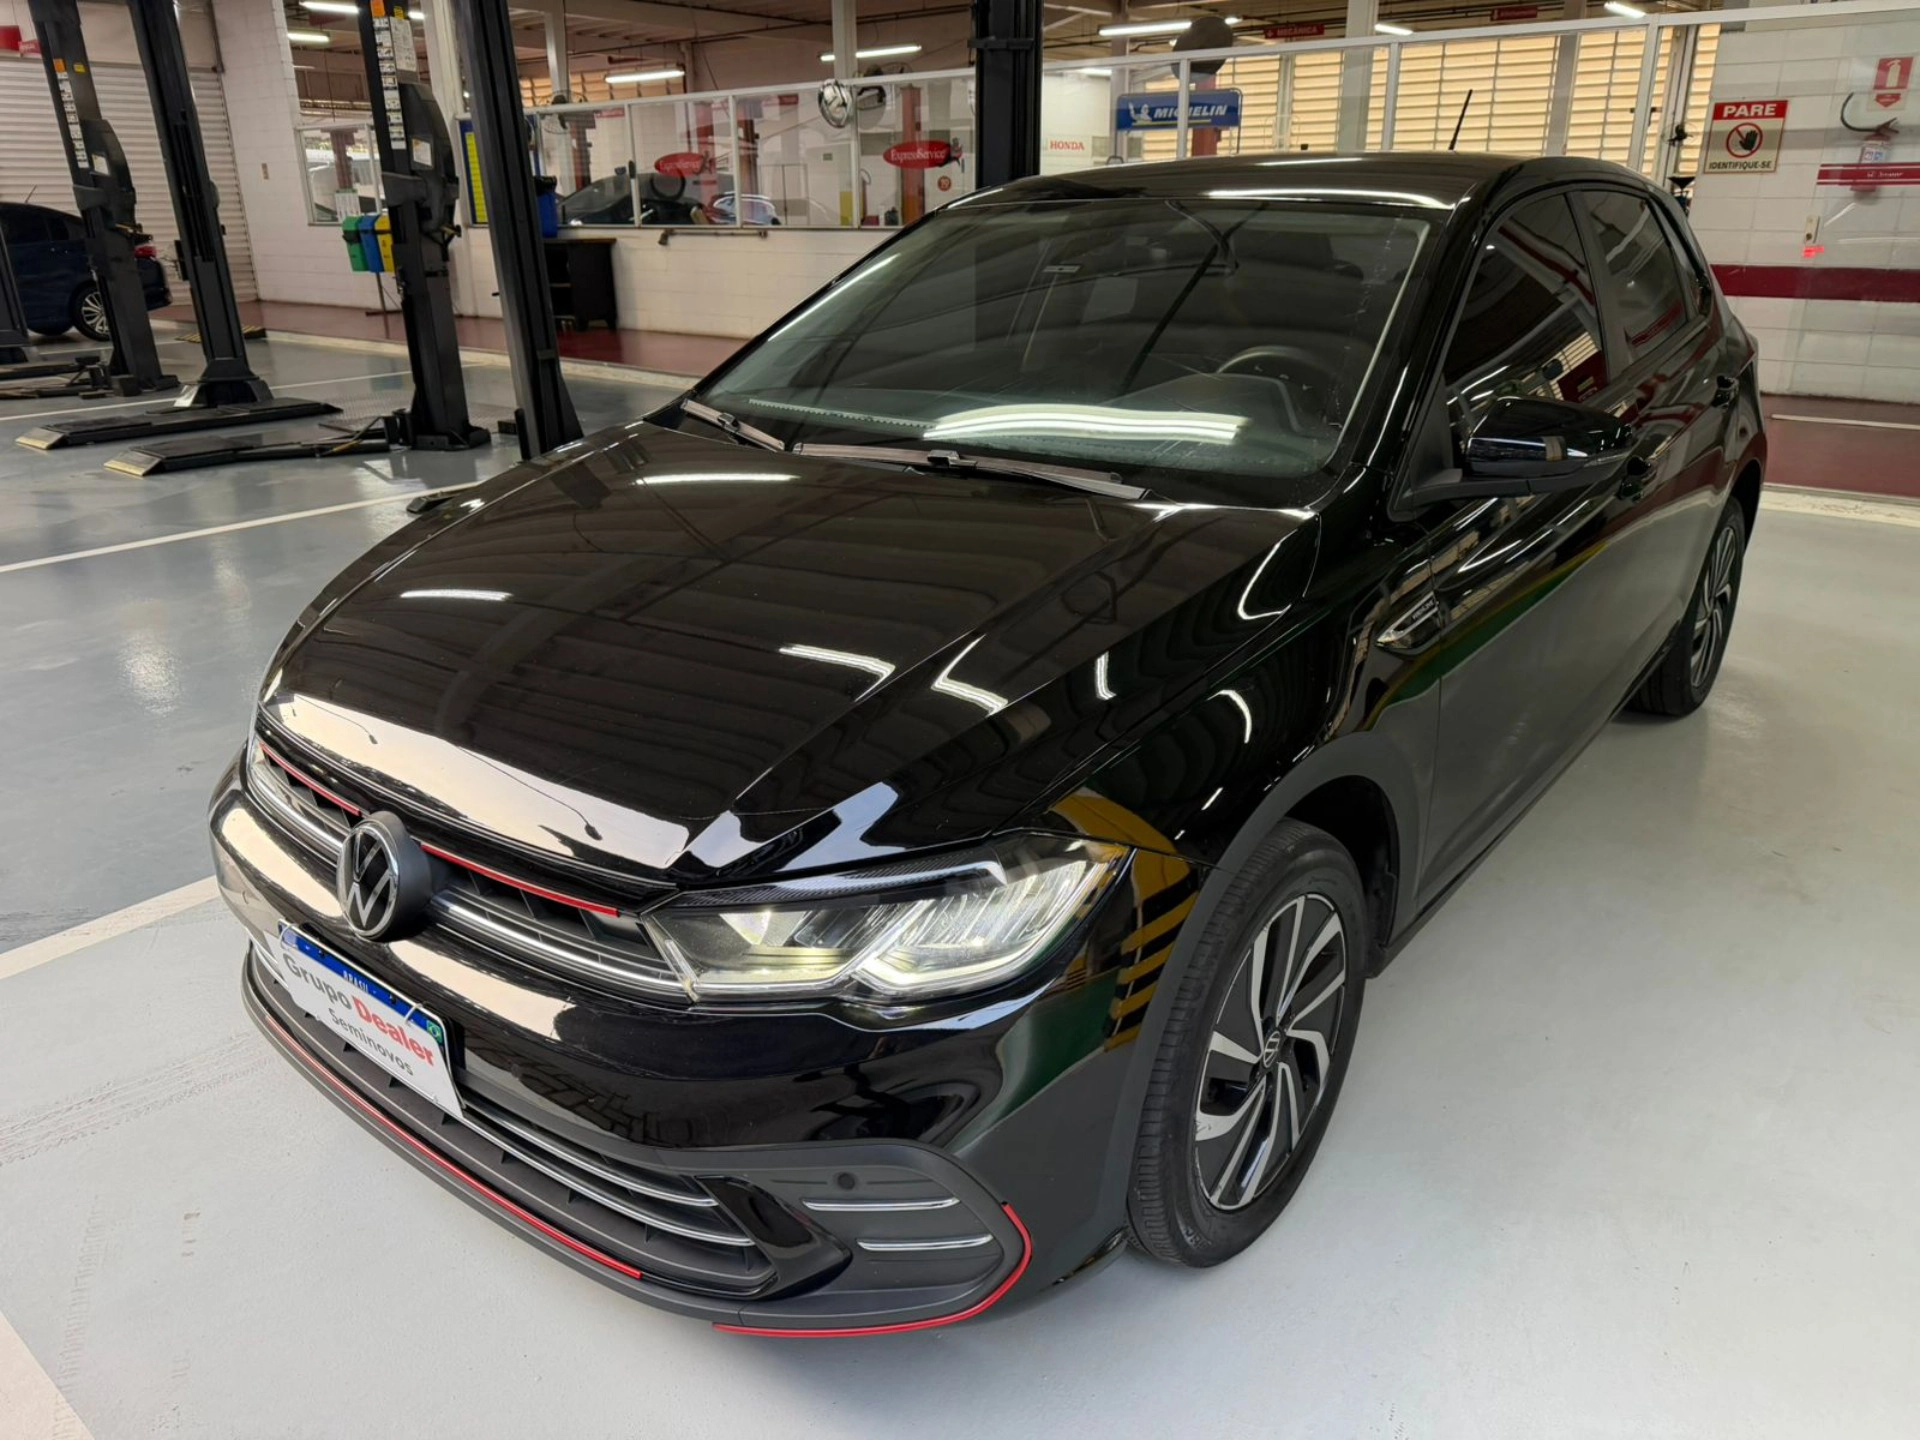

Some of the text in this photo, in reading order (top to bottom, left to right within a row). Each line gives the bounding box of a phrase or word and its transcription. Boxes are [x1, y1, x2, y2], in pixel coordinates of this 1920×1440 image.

[1723, 103, 1777, 118] PARE
[1050, 140, 1085, 151] HONDA
[1709, 161, 1772, 170] IDENTIFIQUE-SE
[342, 970, 369, 994] BRASIL
[283, 953, 435, 1067] Grupo Dealer
[328, 1007, 414, 1076] Seminovos
